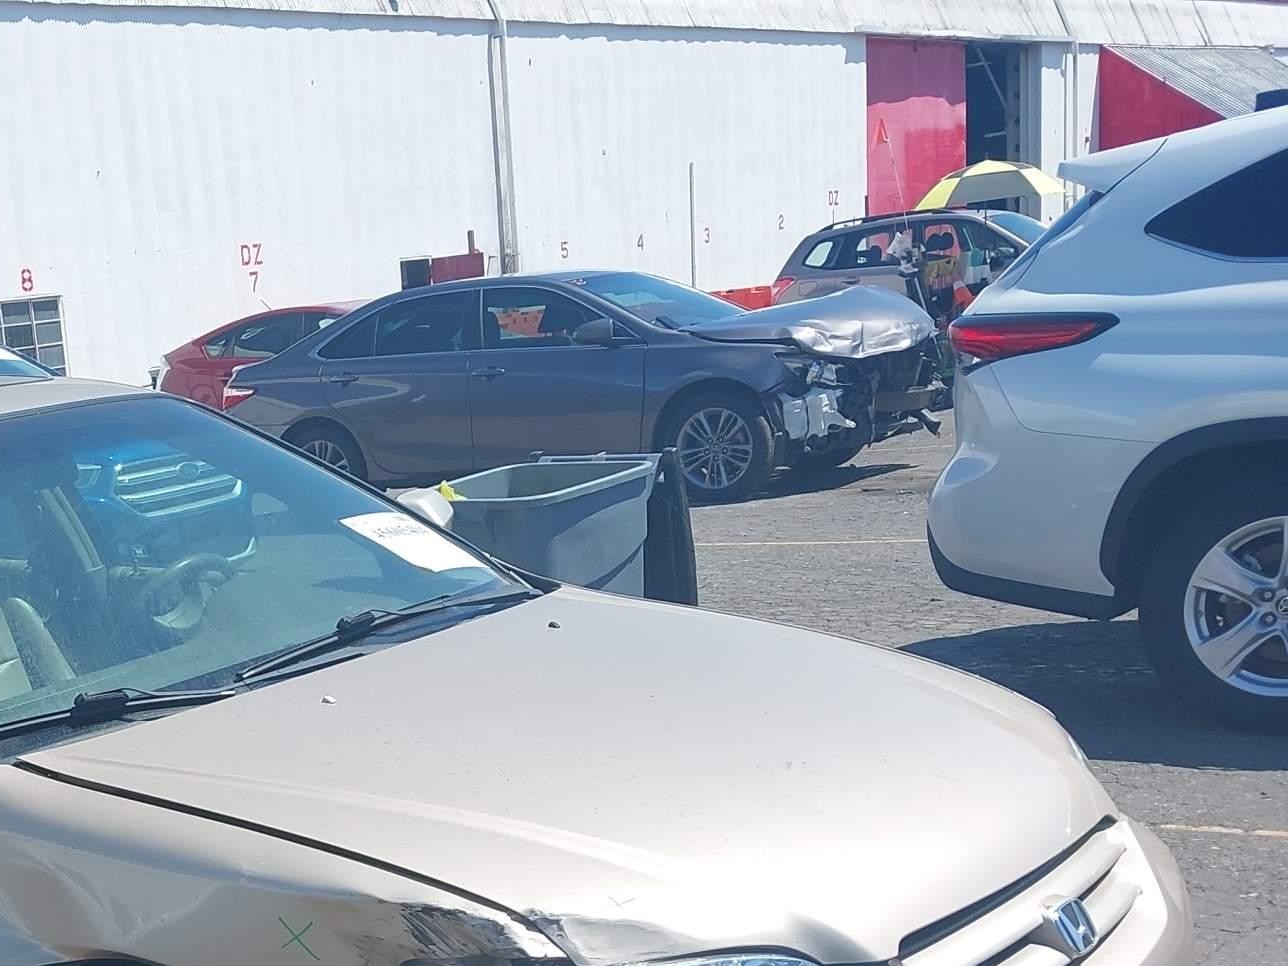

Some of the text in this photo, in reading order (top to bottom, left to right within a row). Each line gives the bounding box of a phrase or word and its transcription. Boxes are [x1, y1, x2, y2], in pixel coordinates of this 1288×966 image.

[828, 190, 839, 206] DZ
[778, 214, 785, 230] 2
[636, 233, 645, 251] 4
[704, 227, 711, 244] 3
[240, 243, 264, 266] DZ
[560, 240, 570, 259] 5
[21, 268, 34, 292] 8
[249, 271, 258, 293] 7
